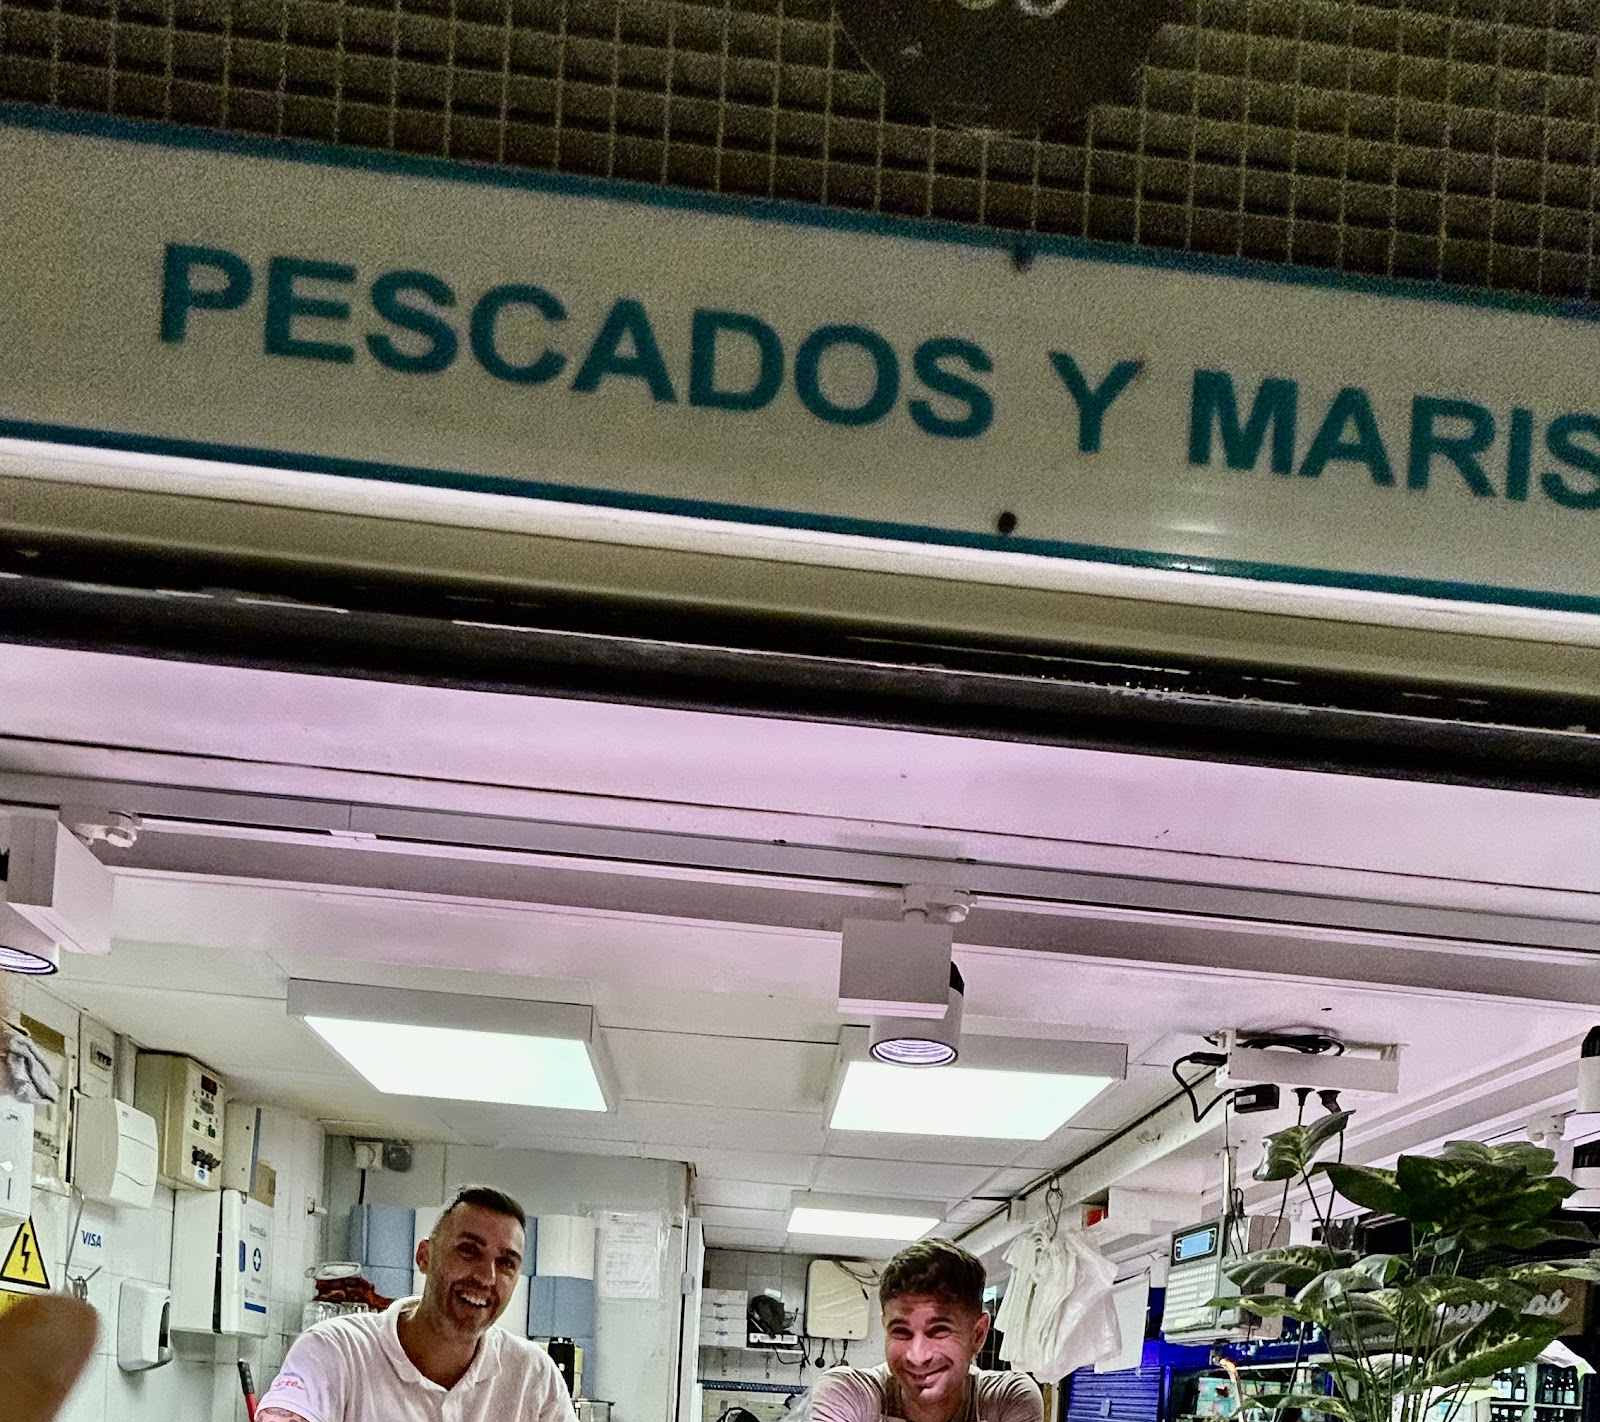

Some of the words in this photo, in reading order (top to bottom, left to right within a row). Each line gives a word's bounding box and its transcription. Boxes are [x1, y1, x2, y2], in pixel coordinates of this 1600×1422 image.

[159, 243, 996, 438] PESCADOS
[1048, 350, 1143, 454] Y
[1187, 368, 1600, 510] MARIS
[81, 1230, 101, 1248] VISA
